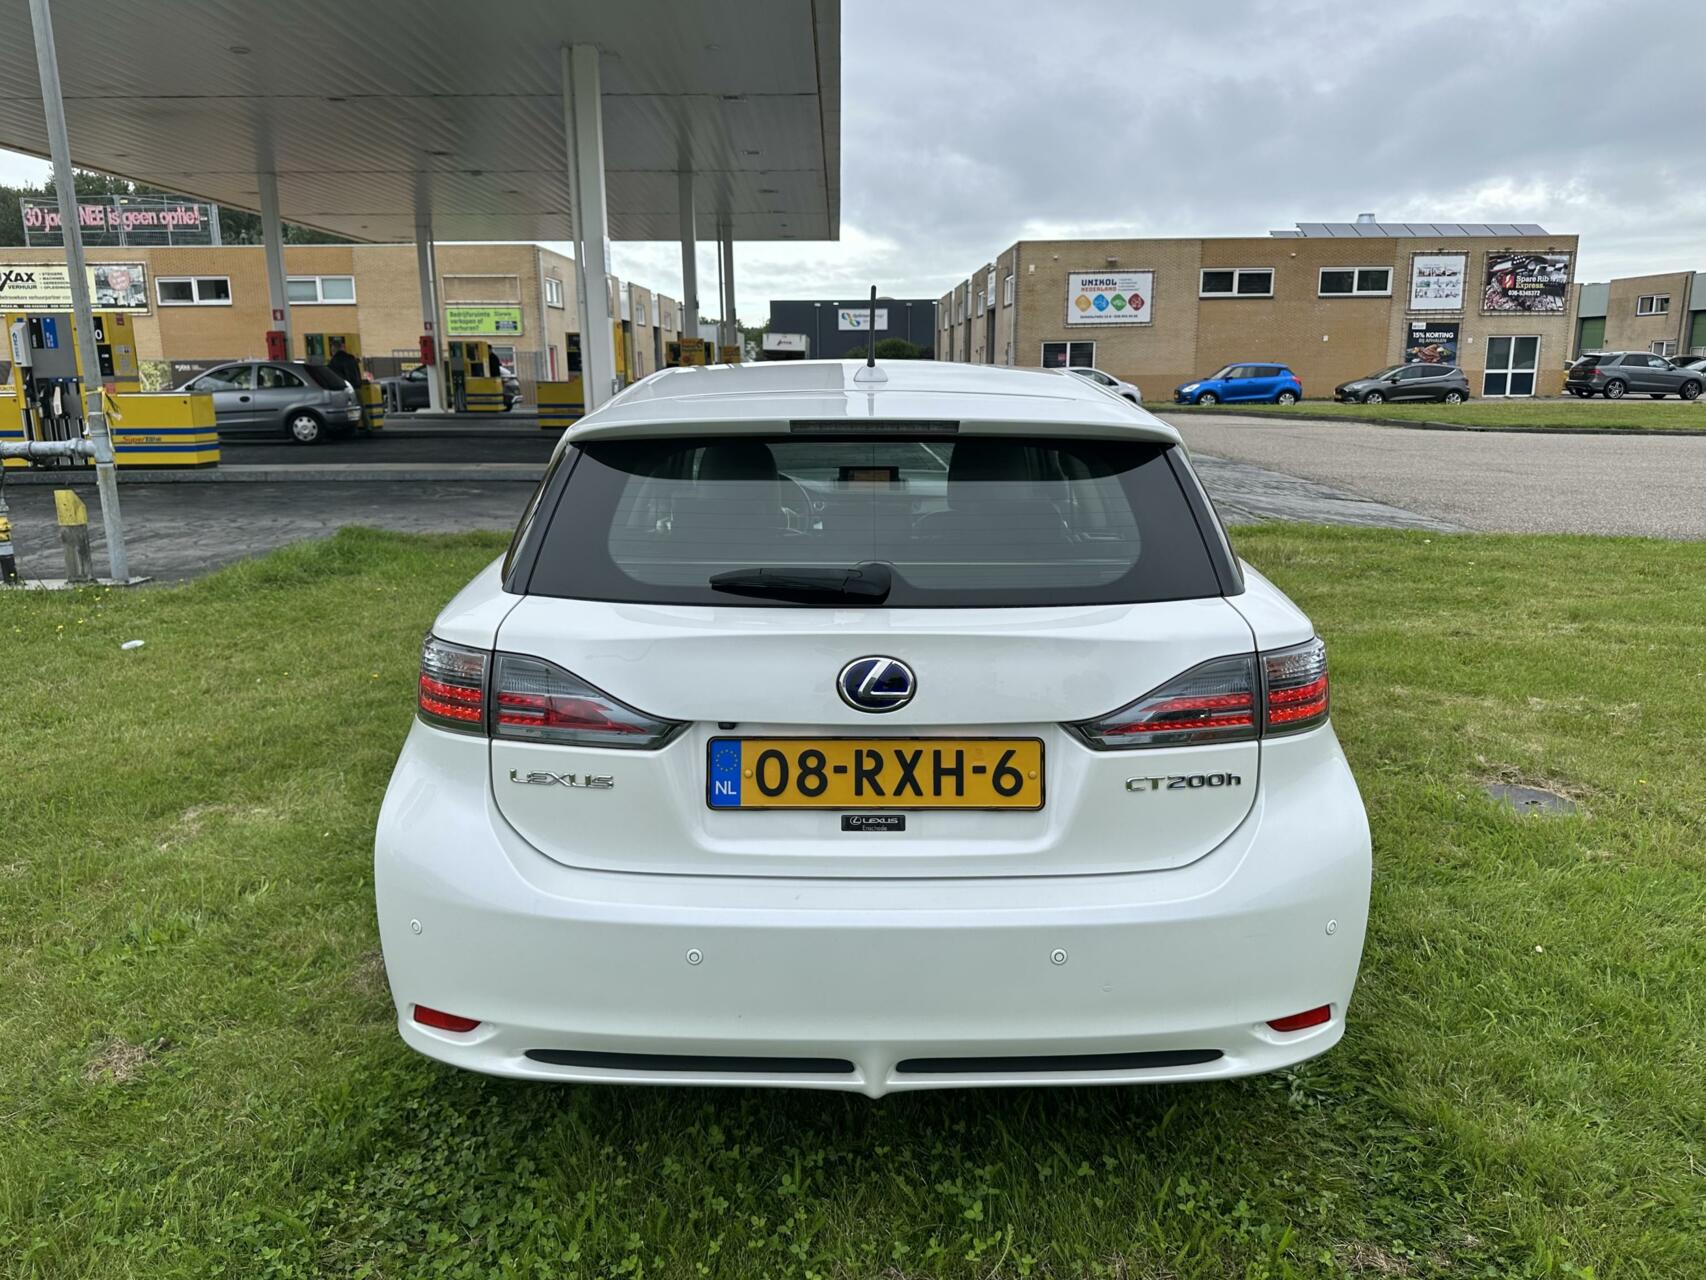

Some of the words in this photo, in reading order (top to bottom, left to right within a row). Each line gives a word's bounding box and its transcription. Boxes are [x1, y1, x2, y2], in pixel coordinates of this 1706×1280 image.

[25, 208, 41, 226] 30
[44, 208, 62, 233] ja
[78, 205, 104, 226] NEE
[108, 206, 120, 226] is
[122, 211, 157, 231] geen
[159, 204, 200, 231] optie!
[0, 270, 37, 292] XAX
[1081, 279, 1117, 287] UNIKOL
[509, 768, 614, 789] LEXUS
[715, 781, 737, 795] NL
[755, 749, 1024, 797] 08-RXH-6
